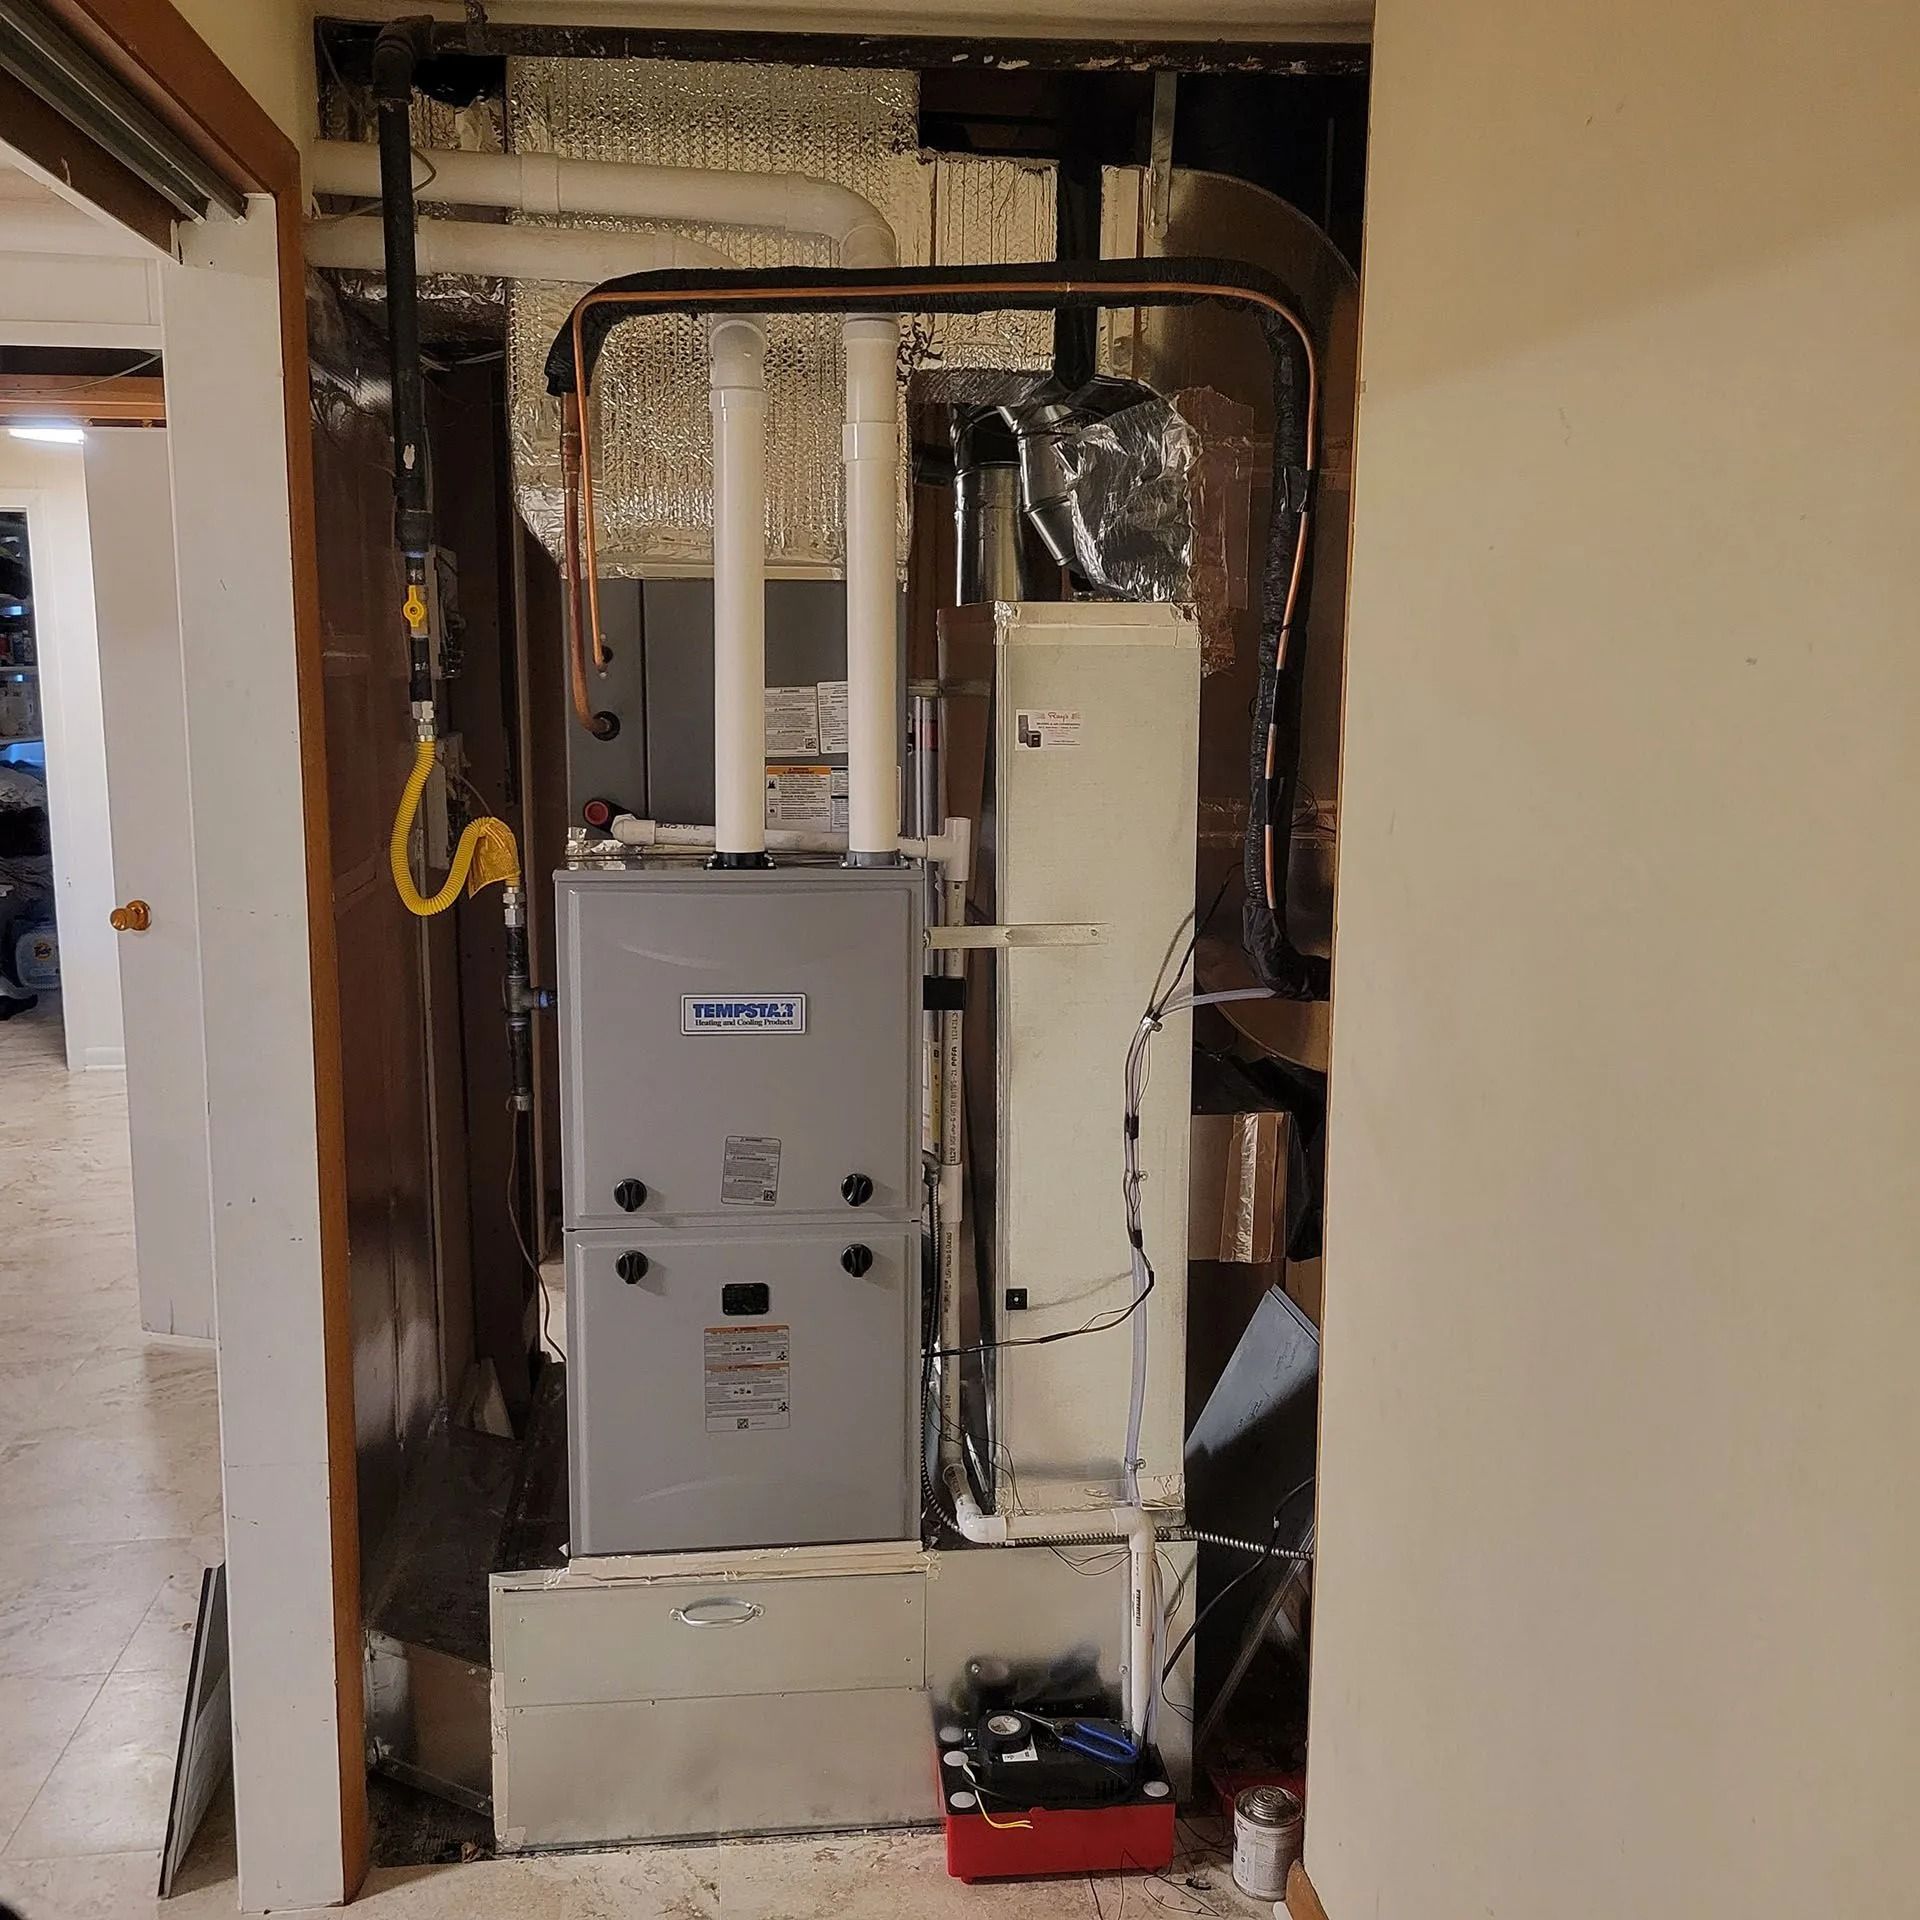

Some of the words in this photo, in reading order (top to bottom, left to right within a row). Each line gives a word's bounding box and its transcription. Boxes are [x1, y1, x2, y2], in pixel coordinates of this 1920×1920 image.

[692, 1003, 793, 1018] TEMPSTAR
[695, 1019, 721, 1027] Heating
[737, 1019, 763, 1027] Cooling
